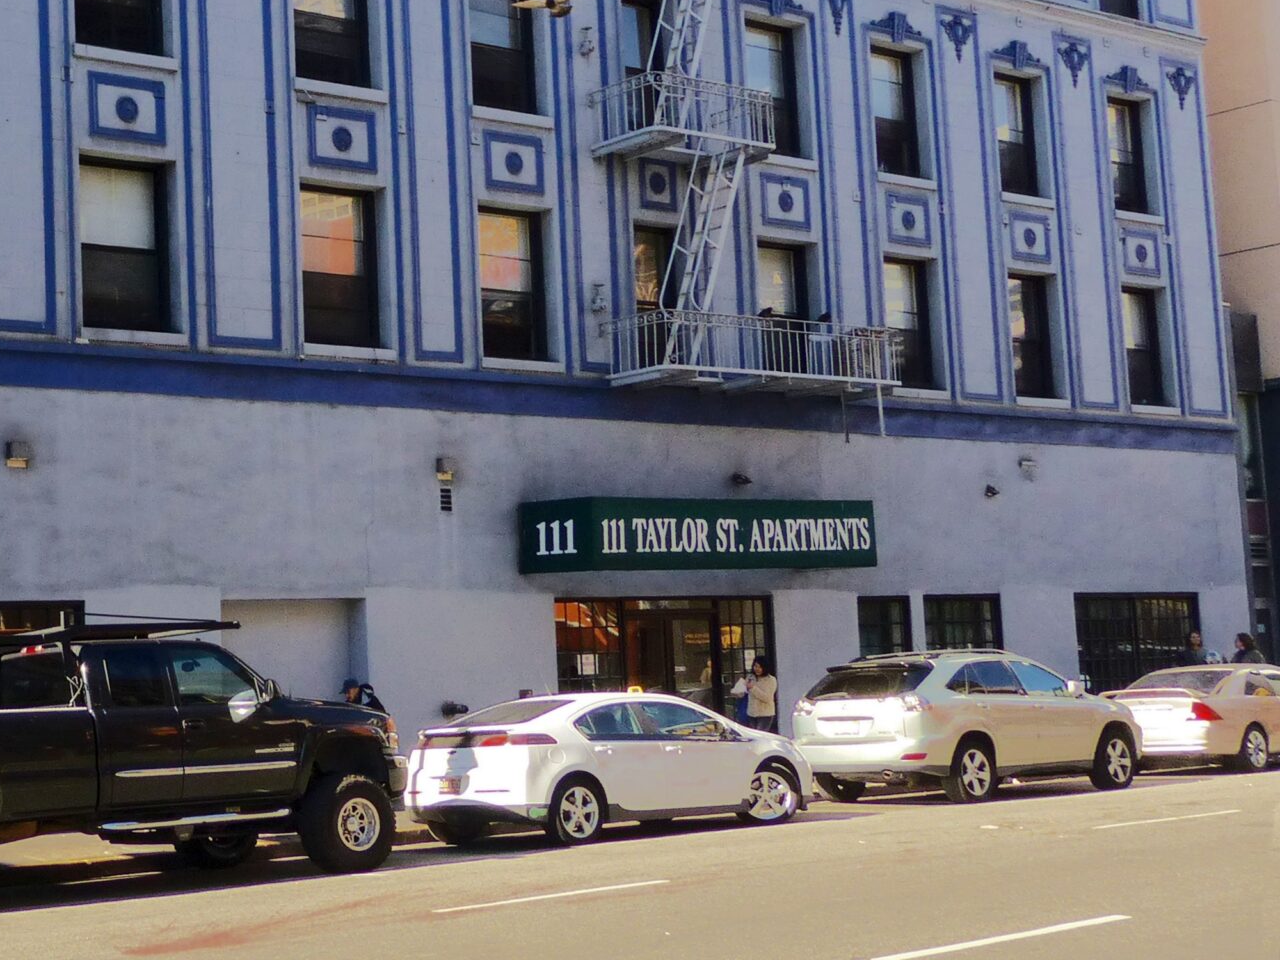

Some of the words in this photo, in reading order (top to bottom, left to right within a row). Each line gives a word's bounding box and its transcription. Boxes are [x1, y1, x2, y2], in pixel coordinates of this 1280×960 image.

[536, 519, 577, 556] 111
[601, 518, 627, 554] 111
[632, 517, 710, 553] TAYLOR
[716, 517, 744, 553] ST.
[750, 517, 871, 553] APARTMENTS
